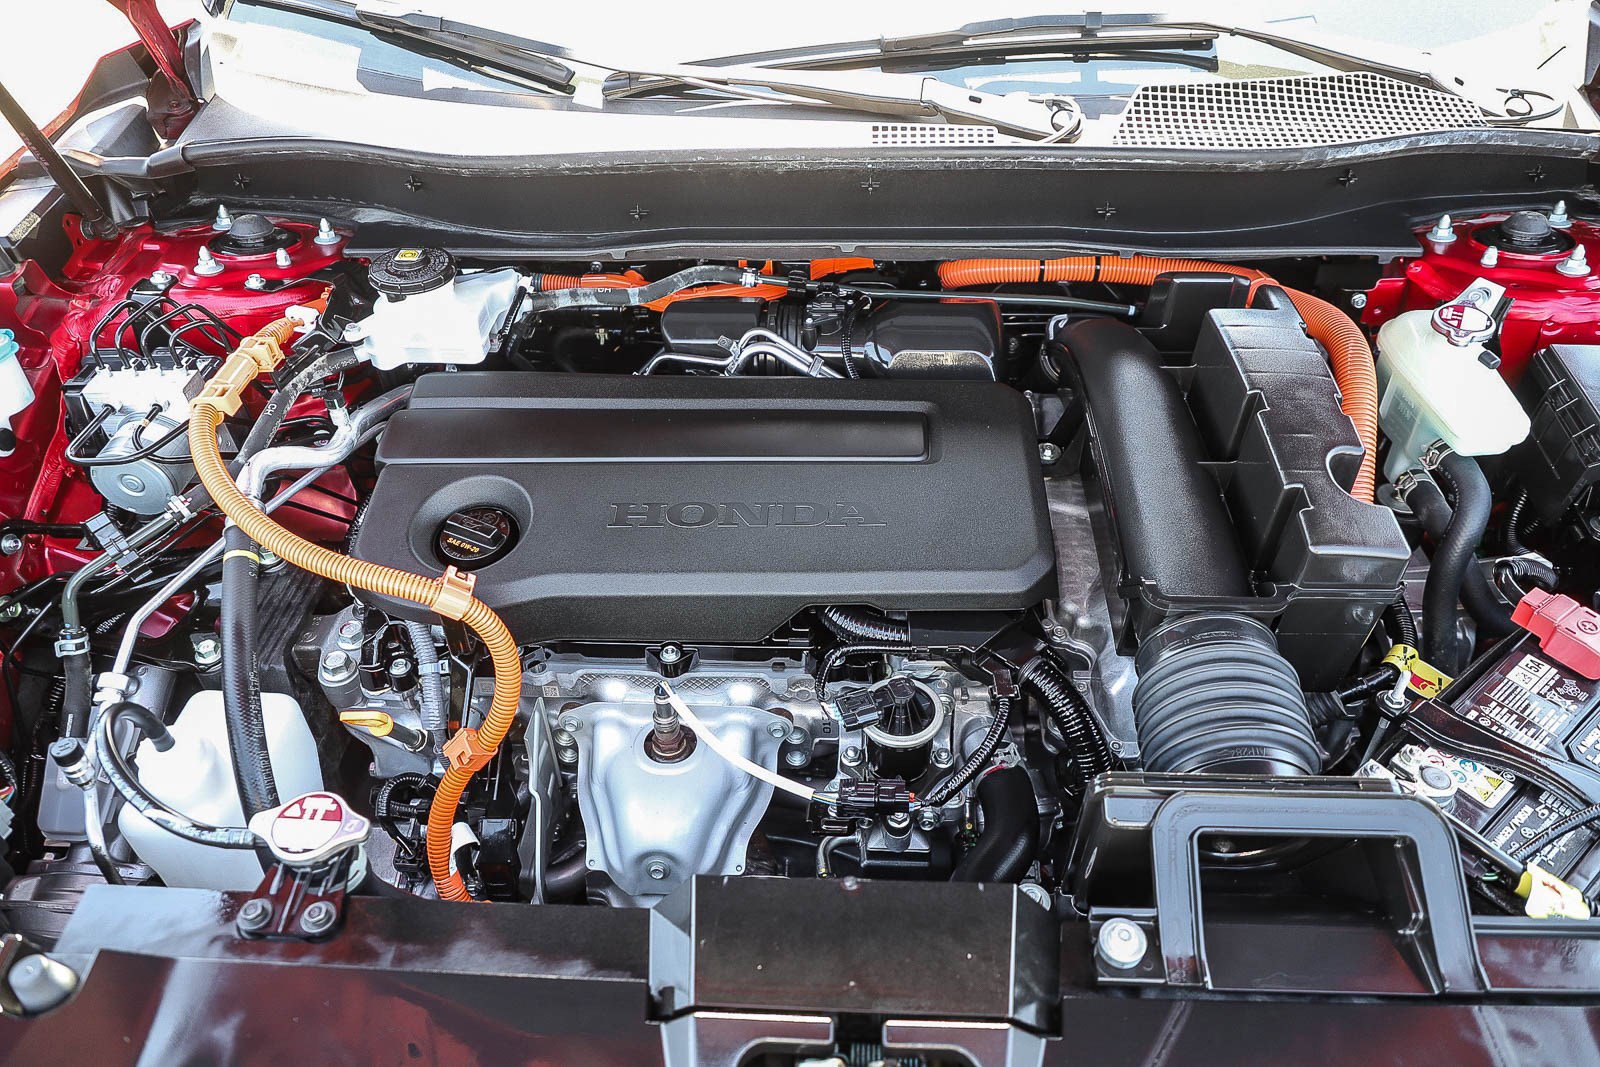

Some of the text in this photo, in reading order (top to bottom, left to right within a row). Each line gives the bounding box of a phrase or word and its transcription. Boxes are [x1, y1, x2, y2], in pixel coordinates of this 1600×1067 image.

[606, 501, 887, 528] HONDA
[447, 537, 461, 547] SAE
[460, 541, 480, 553] 0W-20
[1491, 804, 1535, 848] DANGER/POISON
